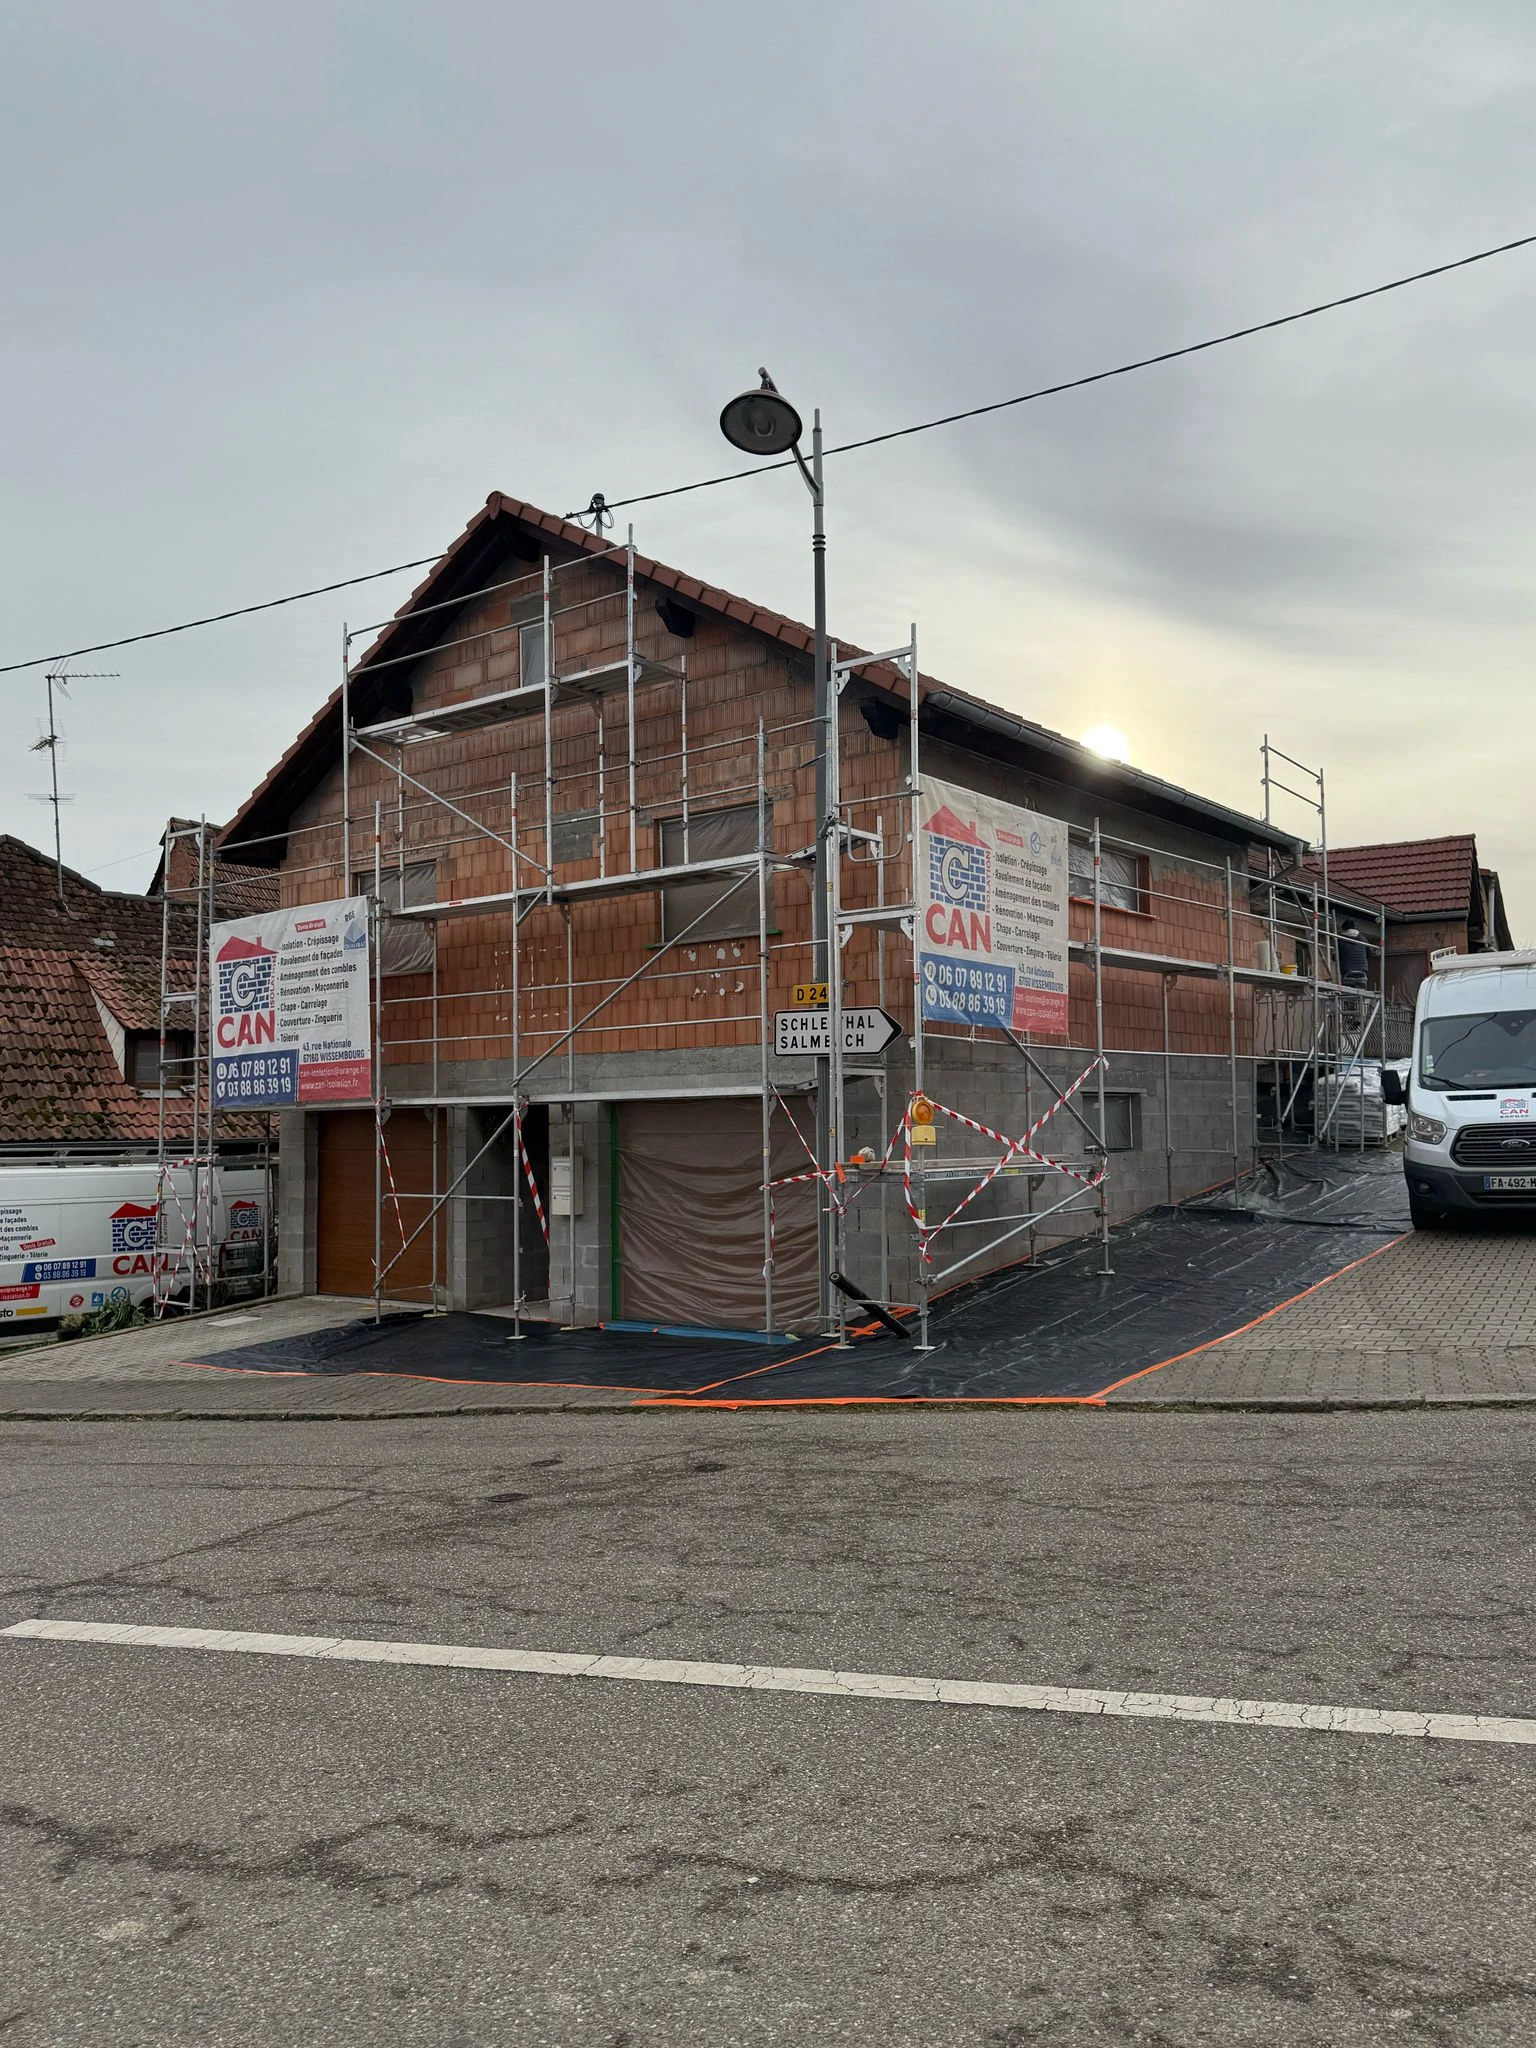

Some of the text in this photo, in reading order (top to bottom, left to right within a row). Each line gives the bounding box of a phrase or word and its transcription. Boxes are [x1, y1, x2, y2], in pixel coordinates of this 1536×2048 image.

[995, 851, 1018, 867] Isolation
[1024, 878, 1032, 888] de
[1031, 896, 1042, 907] des
[925, 903, 992, 954] CAN
[996, 922, 1041, 942] Chape Carrelage
[307, 935, 340, 948] Crépissage
[996, 940, 1024, 955] Couverture
[280, 949, 344, 966] Ravalement de façades
[280, 963, 357, 981] Aménagement des combles
[938, 964, 1007, 994] 06 07 89 12 91
[280, 979, 349, 997] Rénovation Maçonnerie
[796, 988, 805, 1002] D
[280, 999, 328, 1013] Chape Carrelage
[939, 988, 1006, 1016] 03 88 86 39 19
[280, 1012, 343, 1027] Couverture Zinguerie
[780, 1015, 875, 1032] SCHLEHAL
[217, 1010, 276, 1049] CAN
[280, 1032, 300, 1043] Tôlerie
[303, 1038, 352, 1052] 43, rue Nationale
[780, 1034, 864, 1049] SALMBCH
[319, 1049, 365, 1062] WISSEMBOURG
[241, 1060, 252, 1078] 07
[253, 1059, 266, 1077] 89
[267, 1058, 278, 1076] 12
[280, 1056, 291, 1074] 91
[227, 1076, 292, 1098] 03 88 86 39 19
[4, 1216, 28, 1225] façades
[15, 1224, 39, 1232] combles
[230, 1229, 262, 1241] CAN
[29, 1251, 49, 1259] Tôlerie
[43, 1260, 87, 1271] 06 07 89 12 91
[43, 1268, 87, 1280] 03 88 86 39 19
